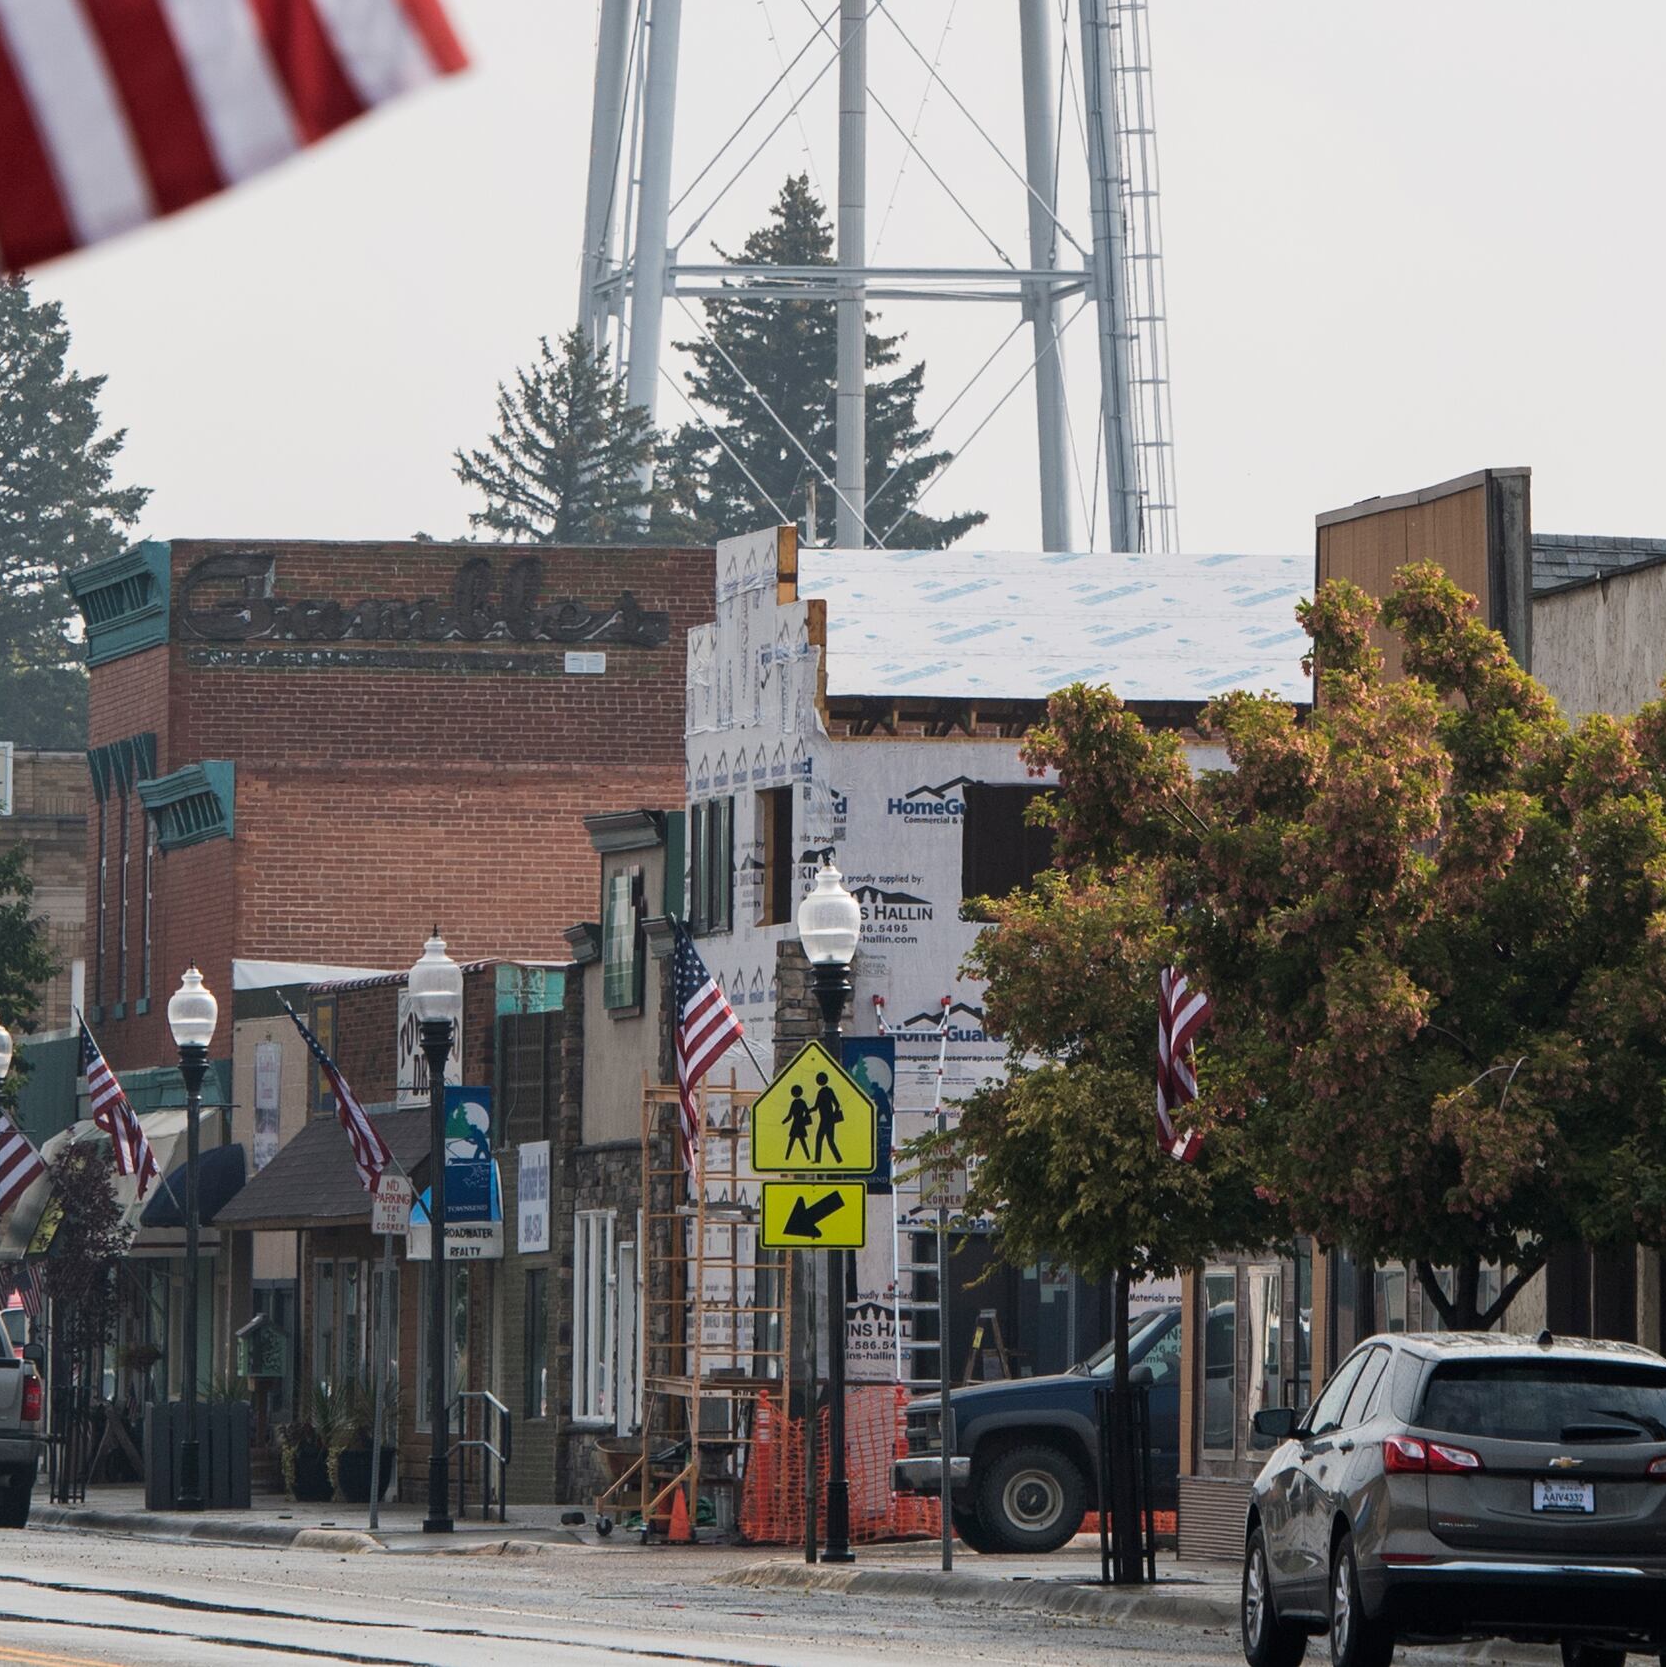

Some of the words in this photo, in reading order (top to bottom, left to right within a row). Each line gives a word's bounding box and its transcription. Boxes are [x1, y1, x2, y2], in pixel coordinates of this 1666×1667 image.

[903, 816, 950, 824] Commercial
[847, 874, 876, 886] proudly
[878, 874, 909, 884] supplied
[874, 905, 933, 921] HALLIN
[386, 1180, 400, 1192] NO
[373, 1192, 410, 1205] PARKING
[446, 1204, 489, 1214] TOWNSEND
[387, 1213, 397, 1222] TO
[449, 1246, 482, 1257] REALTY
[856, 1290, 880, 1301] roudly
